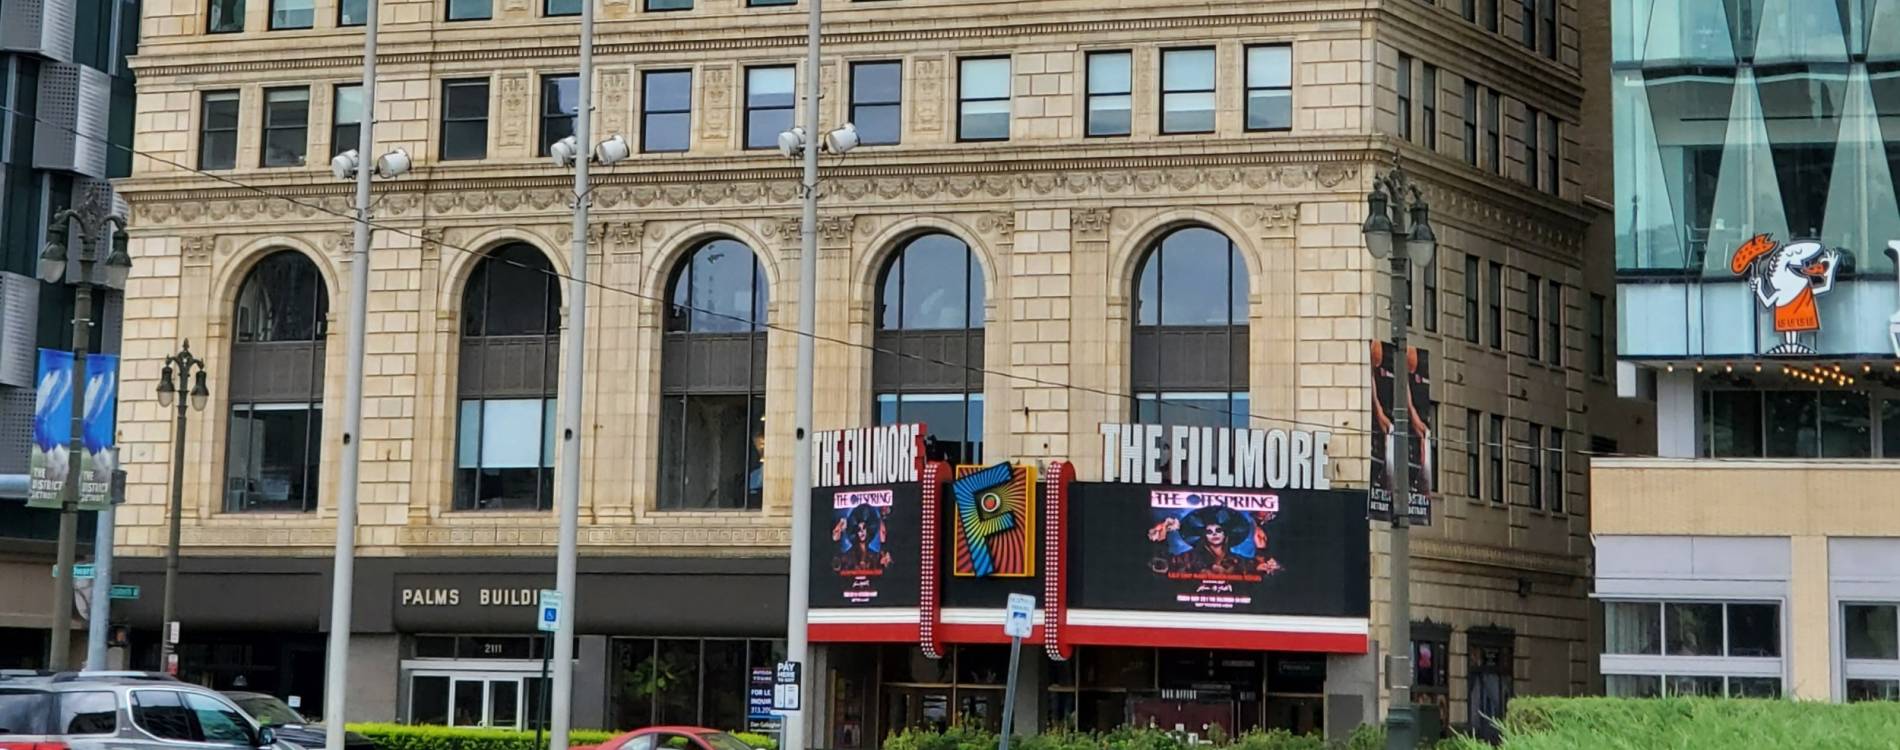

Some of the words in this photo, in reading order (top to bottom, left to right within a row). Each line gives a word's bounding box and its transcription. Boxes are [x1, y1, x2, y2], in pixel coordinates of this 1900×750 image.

[812, 430, 841, 487] THE
[843, 424, 919, 486] FILLMORE
[1099, 423, 1163, 484] THE
[1171, 425, 1332, 490] FILLMORE
[836, 494, 847, 505] THE
[1155, 493, 1181, 506] THE
[1186, 494, 1275, 509] OFFSPRING
[402, 589, 460, 605] PALMS
[480, 589, 538, 605] BUILDI
[484, 643, 502, 653] 2111
[777, 661, 795, 671] PAY
